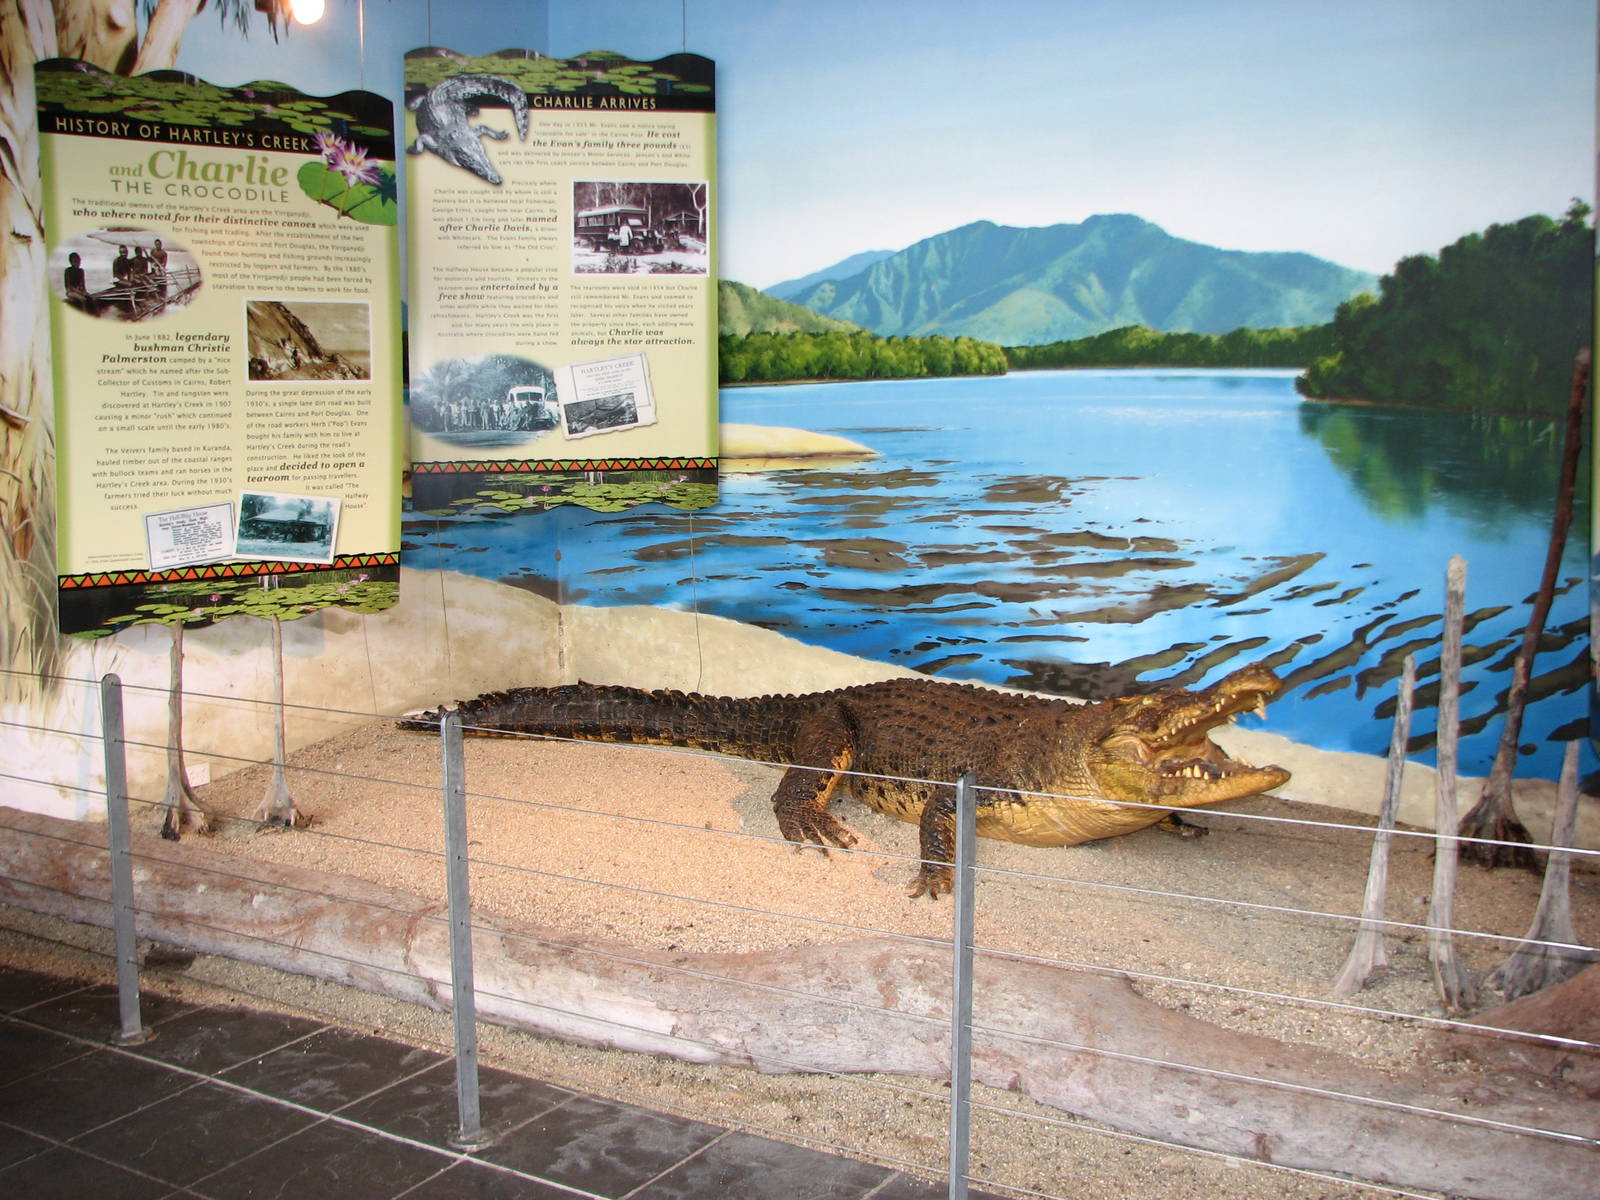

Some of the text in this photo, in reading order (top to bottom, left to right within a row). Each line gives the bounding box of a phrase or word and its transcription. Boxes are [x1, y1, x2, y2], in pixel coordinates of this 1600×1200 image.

[533, 96, 656, 110] CHARLIE ARRIVES
[56, 117, 309, 151] HISTORY OF HARTLEY'S CREEK
[582, 141, 614, 149] family
[643, 142, 677, 150] pounds
[110, 150, 288, 187] and Charlie
[111, 180, 288, 203] THE CROCODILE
[73, 208, 97, 217] who
[101, 209, 136, 219] where
[140, 212, 171, 221] noted
[172, 213, 191, 223] for
[194, 214, 221, 224] their
[223, 216, 279, 226] distinctive
[439, 224, 463, 232] after
[503, 224, 533, 232] Davis,
[480, 283, 536, 291] entertained
[538, 283, 549, 291] by
[437, 293, 458, 301] free
[609, 328, 643, 336] Charlie
[175, 332, 230, 343] legendary
[571, 338, 605, 346] always
[134, 343, 231, 352] bushman Christie
[102, 354, 167, 363] Palmerston
[280, 462, 318, 470] decided
[333, 462, 356, 470] open
[247, 474, 289, 482] tearoom
